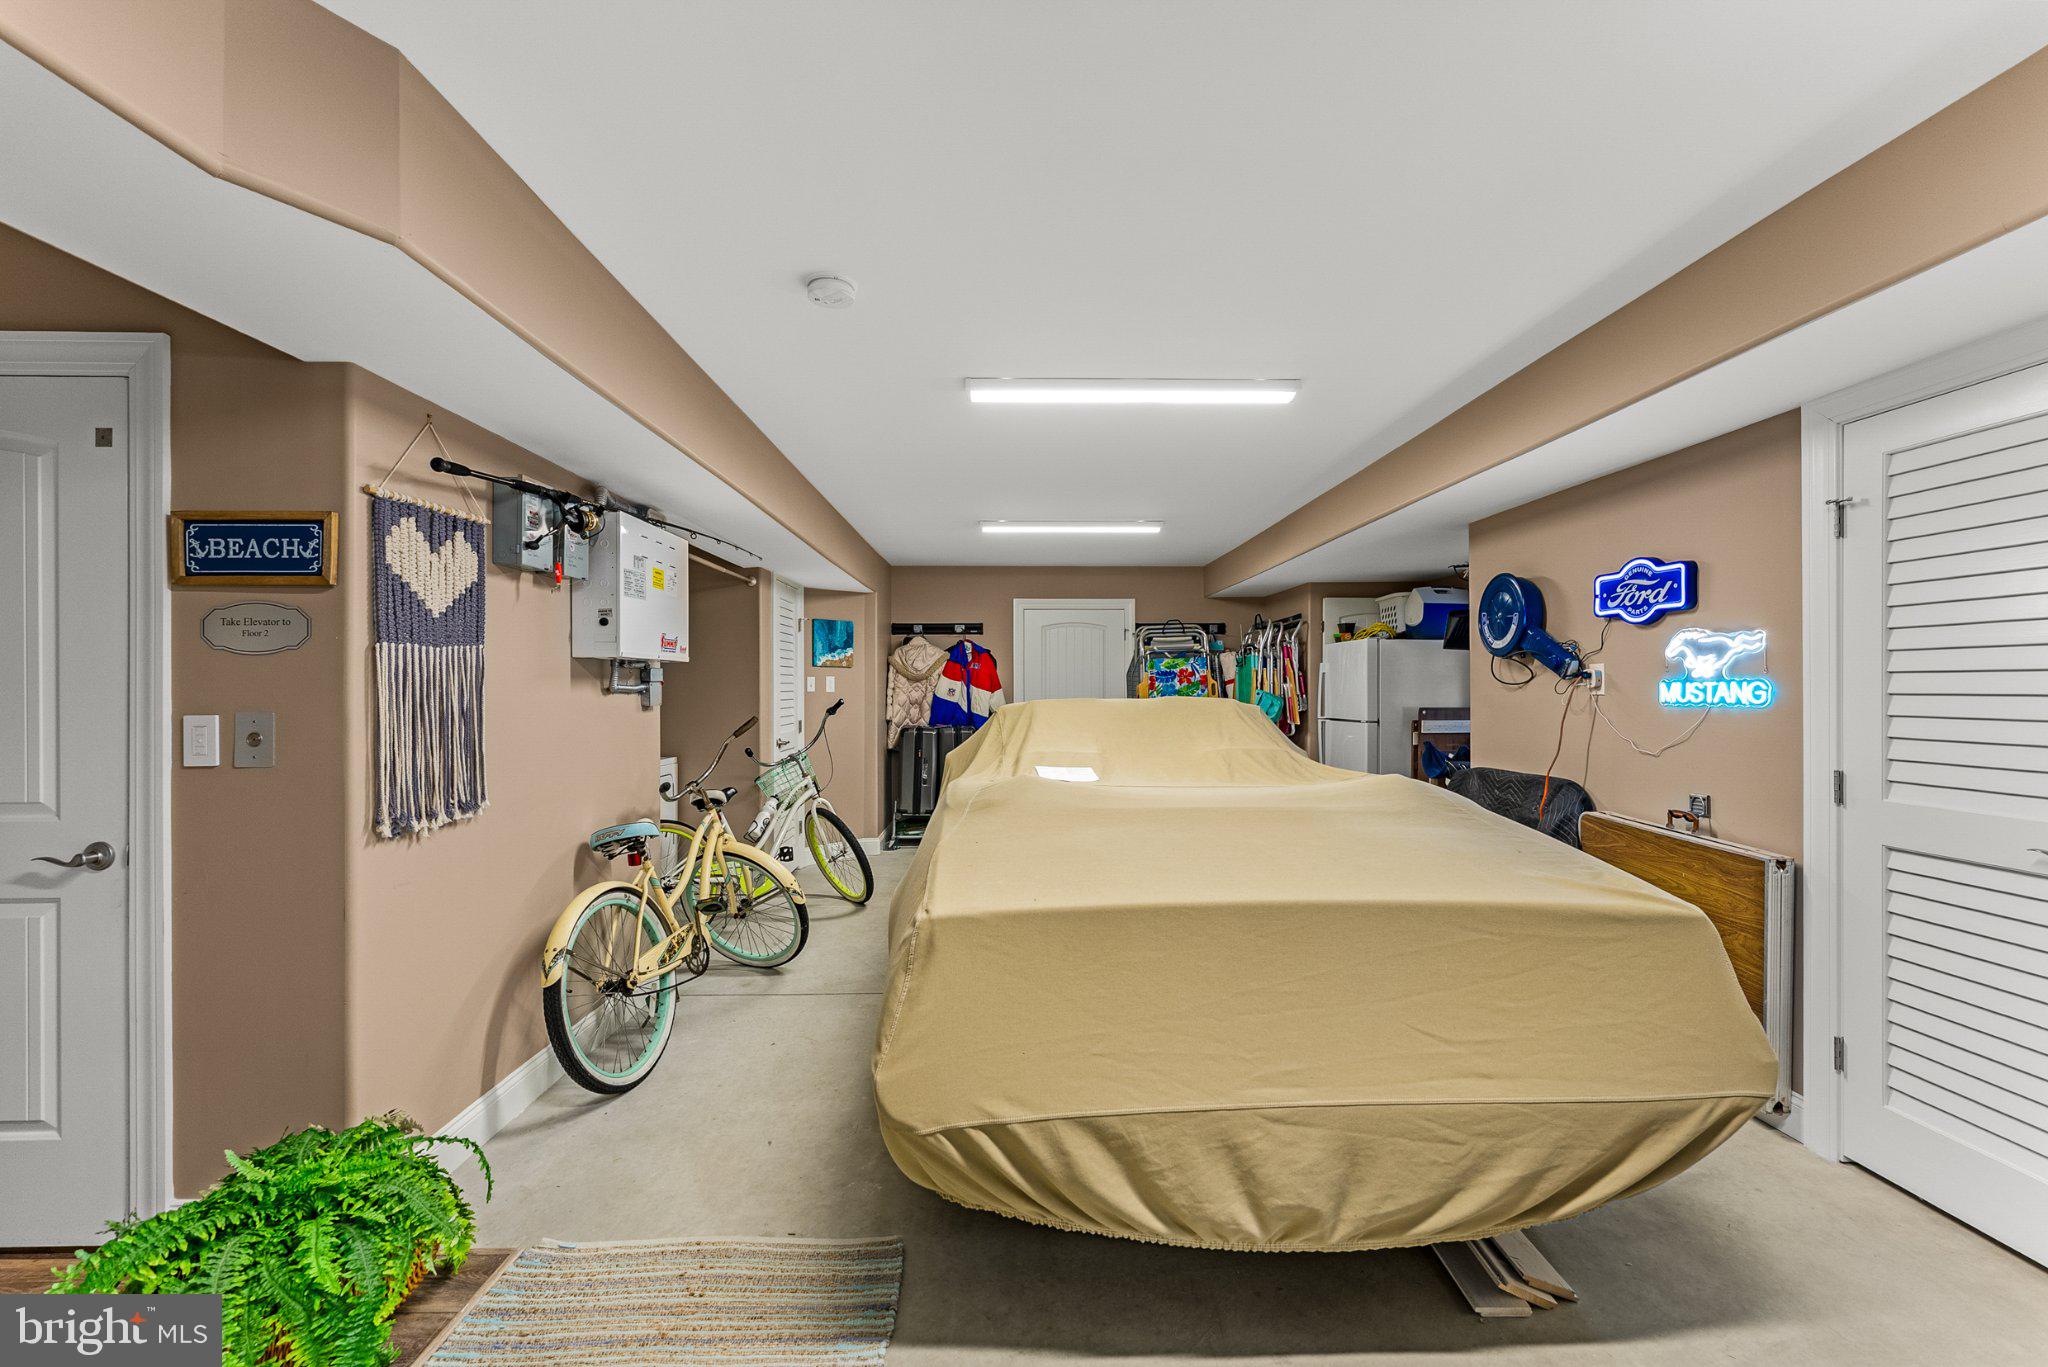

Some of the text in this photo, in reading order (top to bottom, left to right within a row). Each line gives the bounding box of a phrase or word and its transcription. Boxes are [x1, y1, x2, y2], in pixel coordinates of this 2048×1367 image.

[207, 538, 300, 559] BEACH
[1624, 566, 1654, 580] GENUINE
[1607, 578, 1673, 608] Ford
[1627, 605, 1649, 615] PARTS
[220, 617, 291, 627] Take Elevator to
[241, 629, 269, 638] Floor 2
[1659, 681, 1768, 705] MUSTANG
